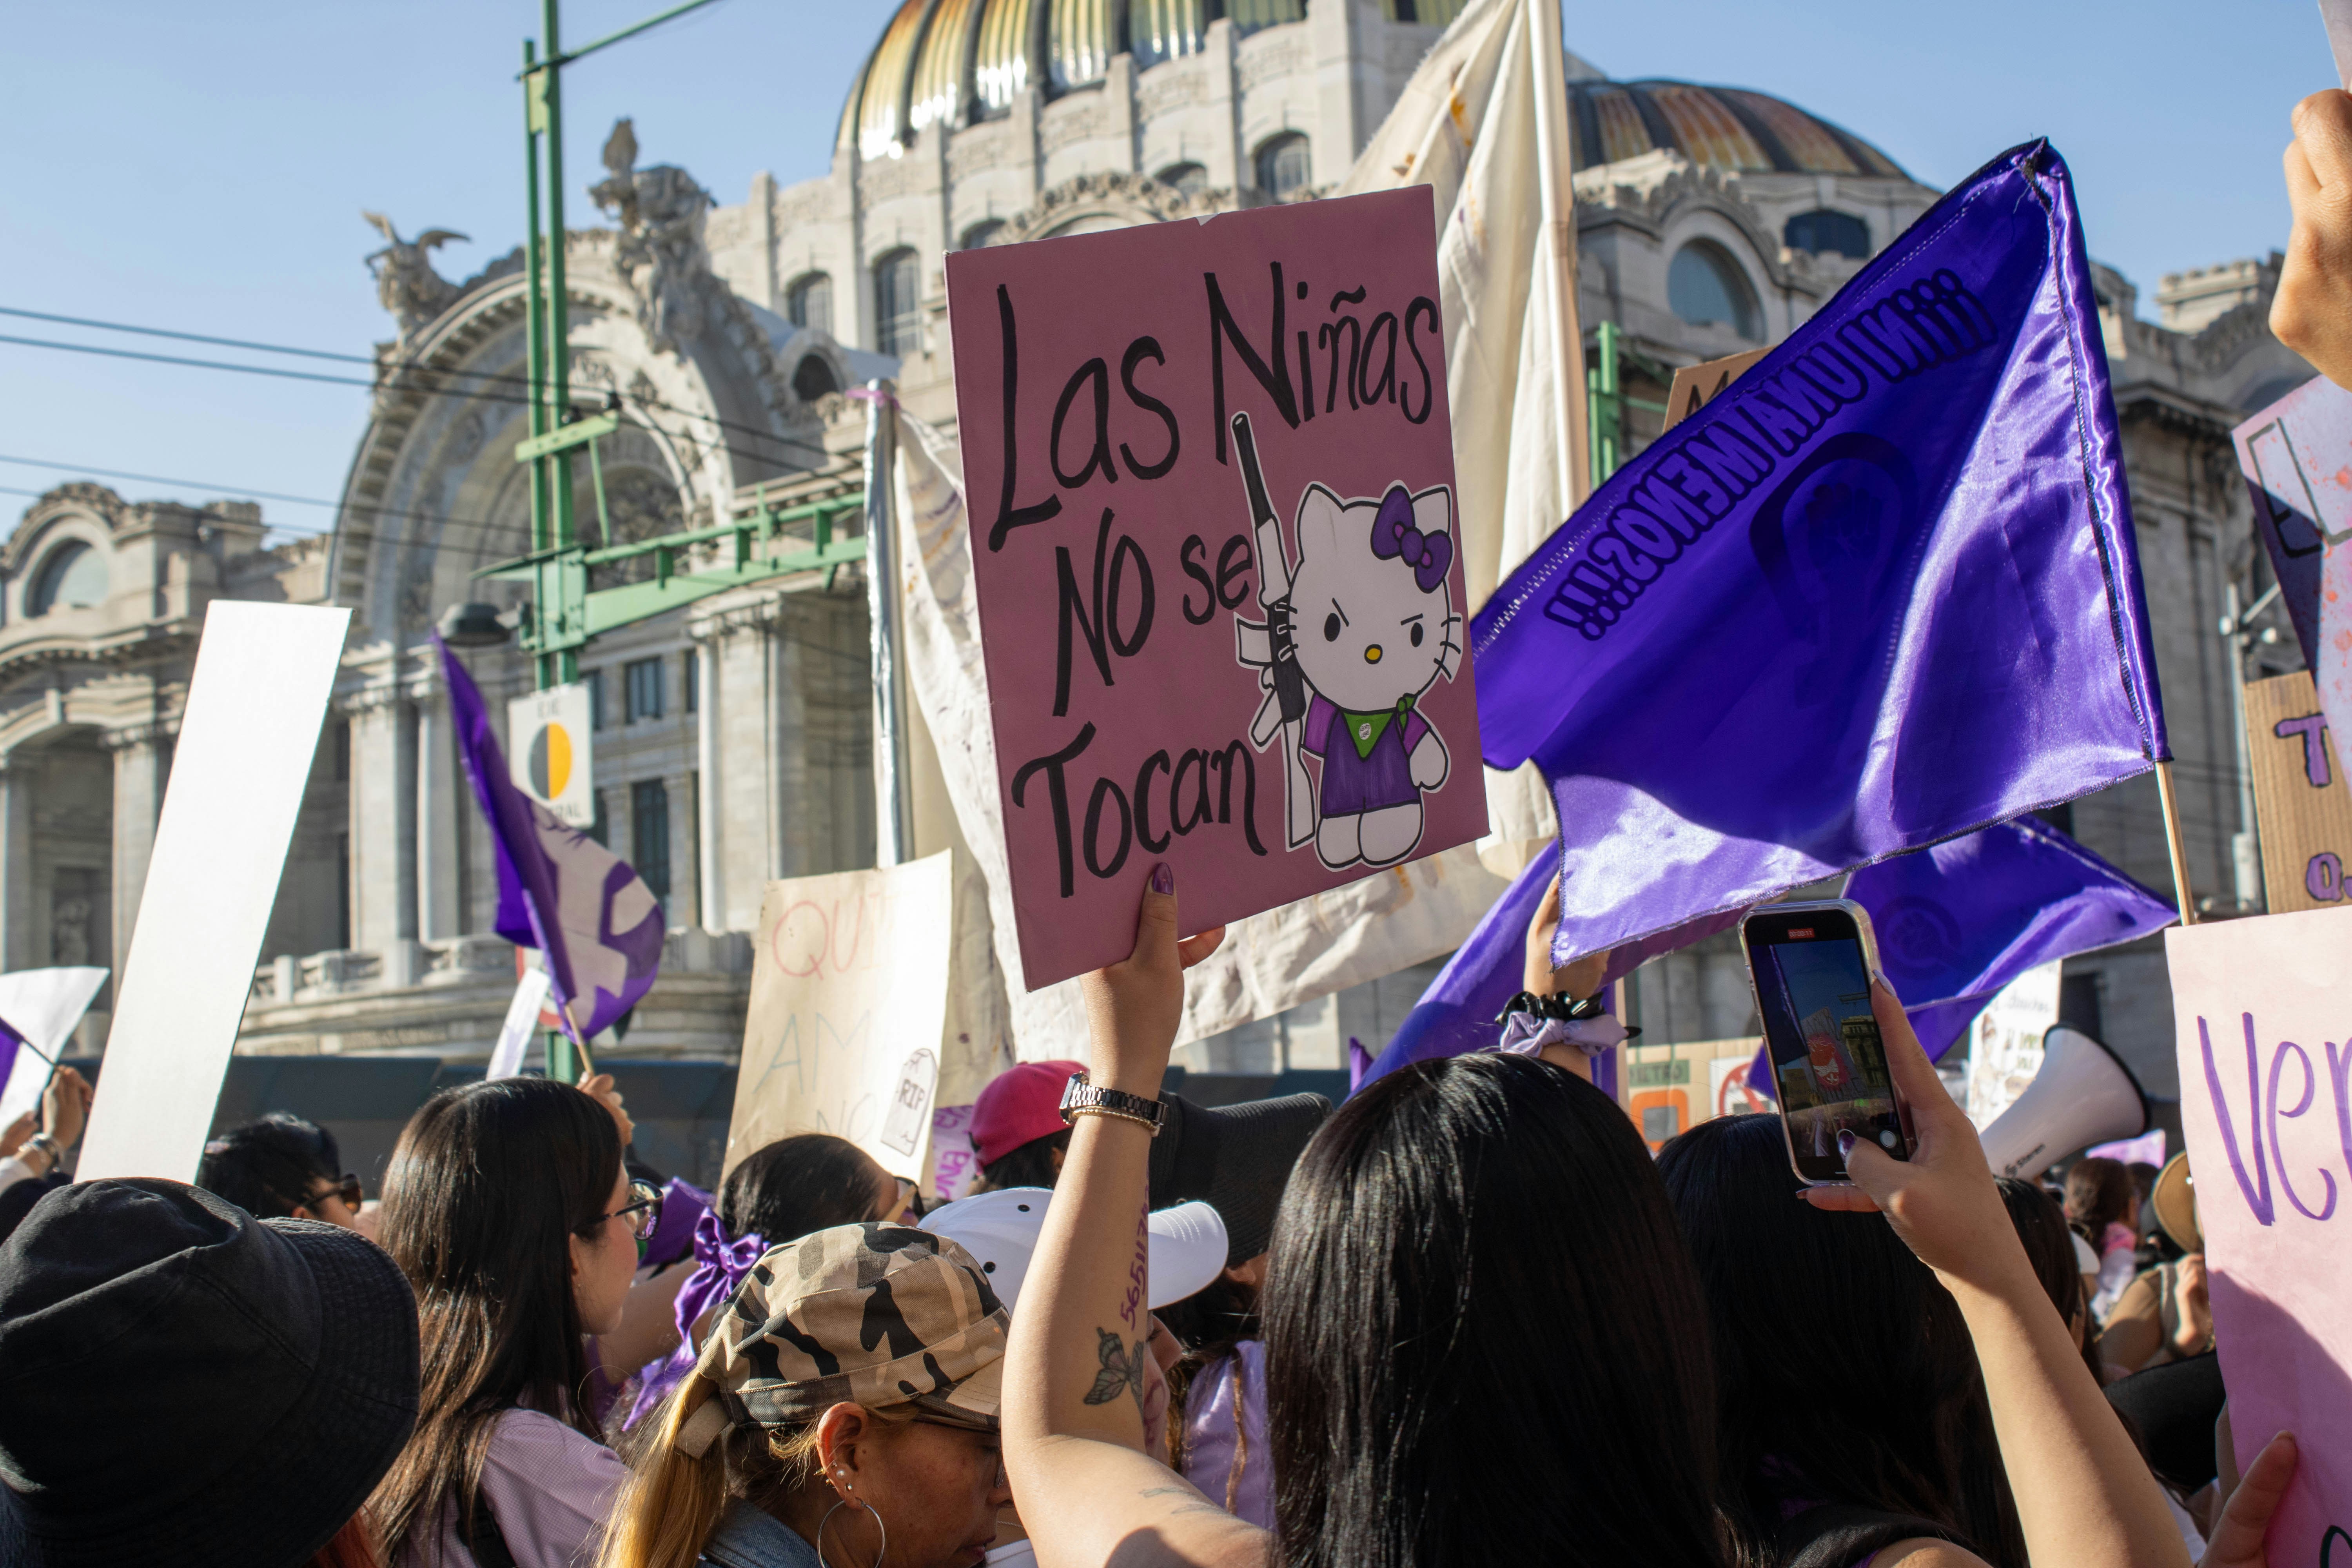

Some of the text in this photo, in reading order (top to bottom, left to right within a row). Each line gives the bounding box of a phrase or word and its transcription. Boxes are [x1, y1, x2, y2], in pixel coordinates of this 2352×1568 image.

[988, 261, 1439, 553] Las Niñas
[1052, 506, 1253, 717] NO se
[1011, 721, 1267, 898] Tocan
